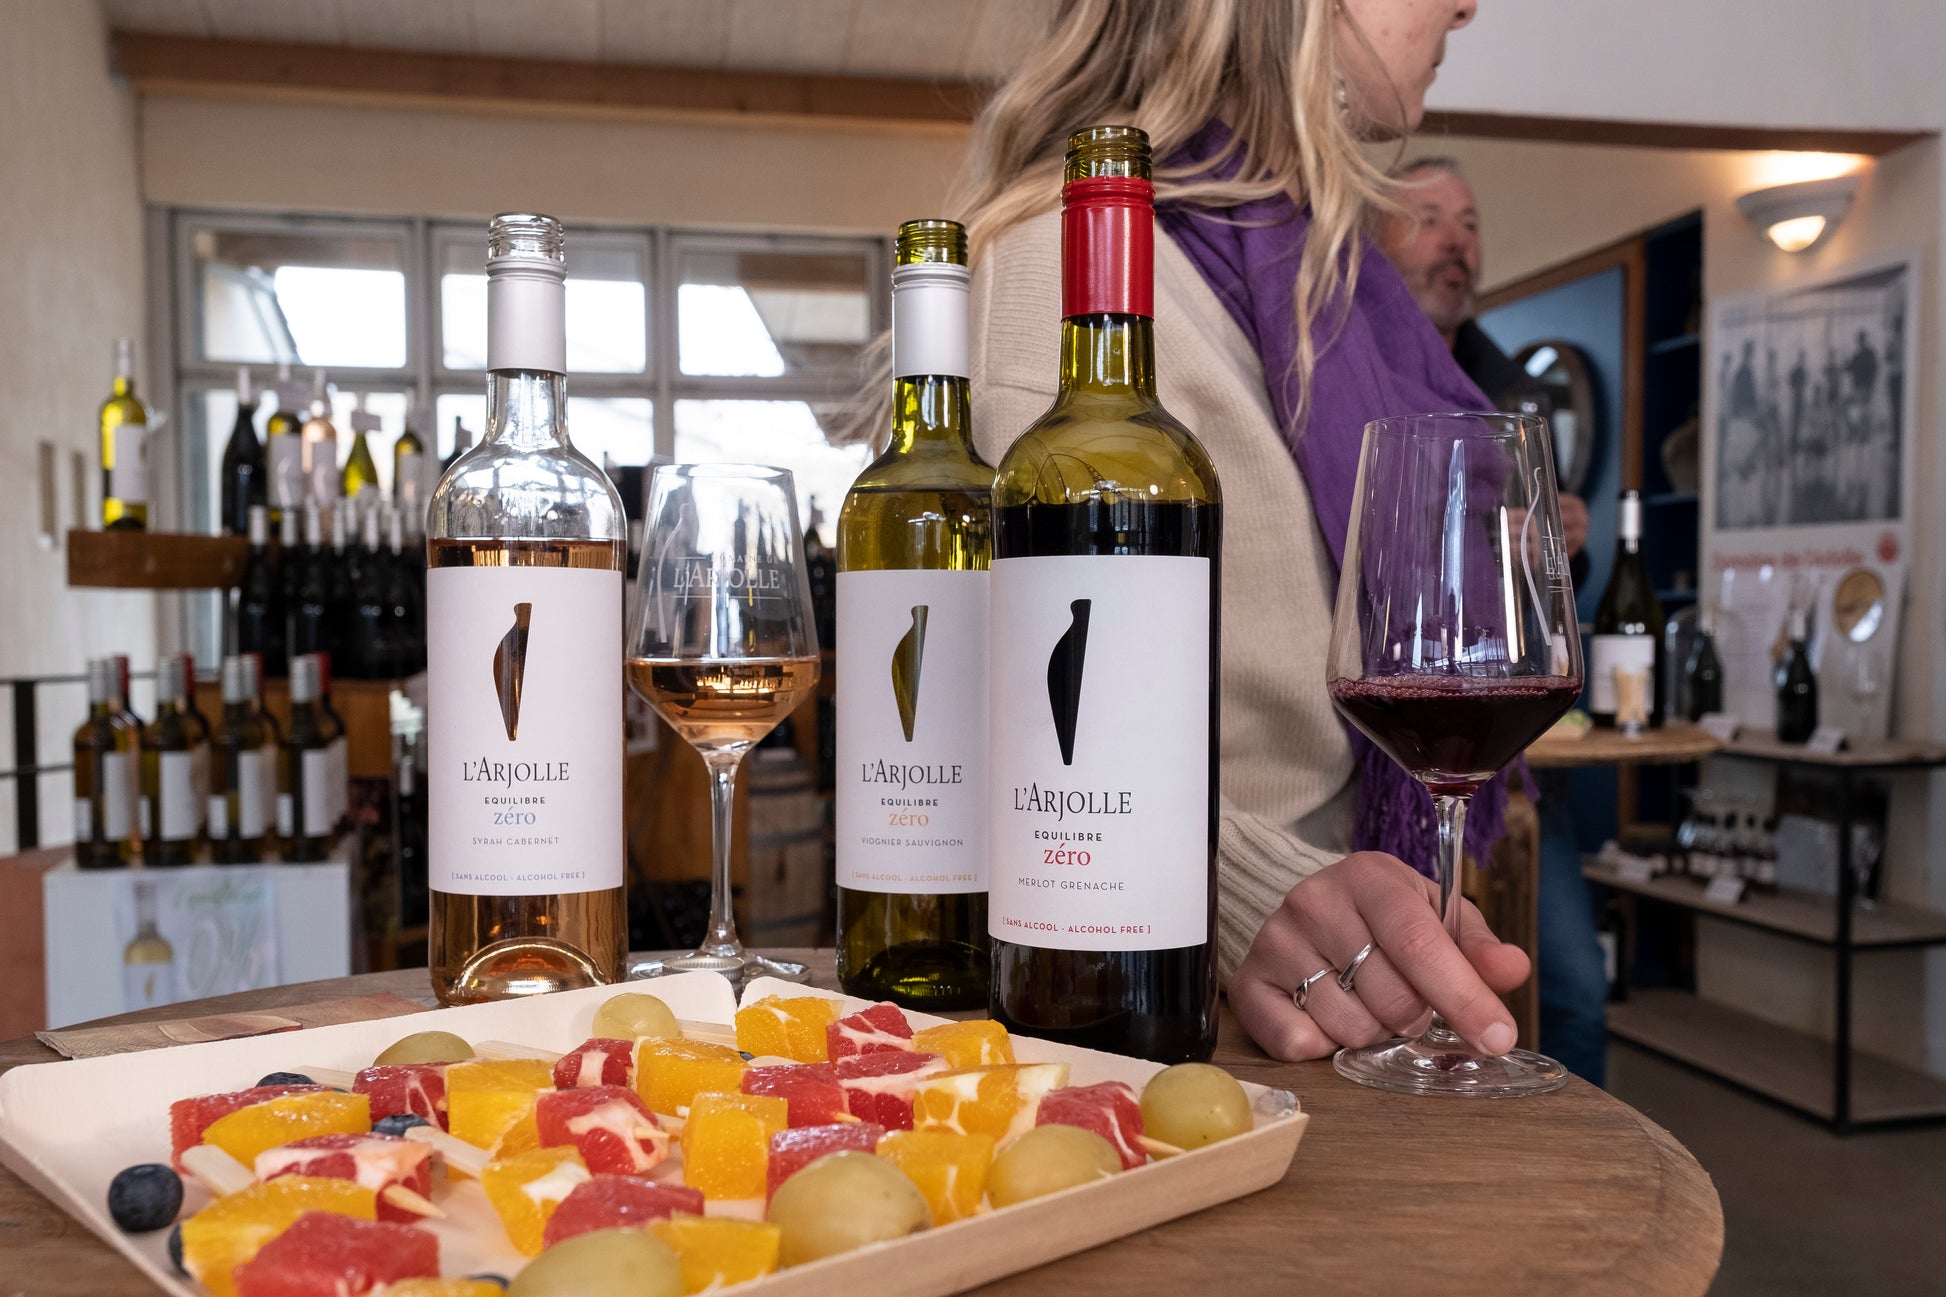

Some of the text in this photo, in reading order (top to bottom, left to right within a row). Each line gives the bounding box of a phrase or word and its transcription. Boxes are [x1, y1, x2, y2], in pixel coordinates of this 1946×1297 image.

[673, 561, 780, 589] L'AROLLE
[463, 756, 570, 789] L'ARJOLLE
[862, 758, 962, 791] L'ARJOLLE
[485, 797, 546, 805] EQUILIBRE
[881, 798, 938, 807] EQUILIBRE
[1014, 782, 1132, 822] L'ARJOLLE
[493, 806, 536, 825] zéro
[889, 808, 929, 827] zéro
[472, 837, 559, 845] SYRAH CABERNET
[1034, 830, 1102, 841] EQUILIBRE
[861, 838, 964, 847] VIOGNIER SAUVIGNON
[1043, 842, 1091, 866] zéro
[475, 873, 508, 881] ALCOOL
[516, 873, 558, 881] ALCOHOL
[872, 873, 902, 881] ALCOOL
[1018, 877, 1124, 891] MERLOT GRENACHE
[1024, 922, 1058, 932] ALCOOL
[1068, 925, 1117, 934] ALCOHOL
[1120, 925, 1144, 934] FREE
